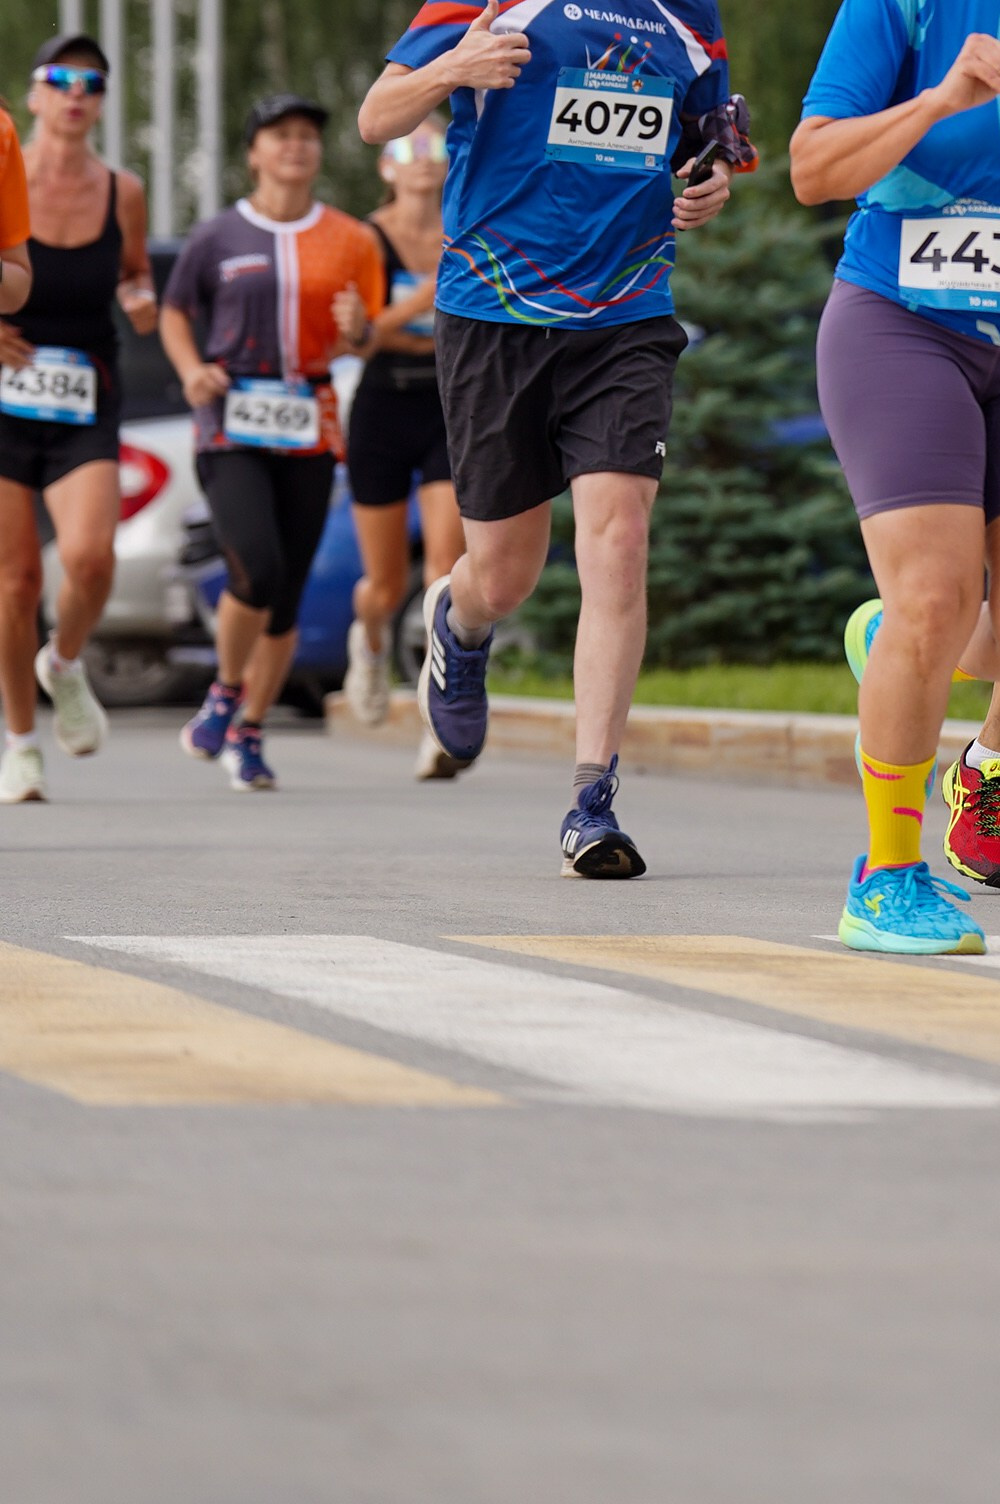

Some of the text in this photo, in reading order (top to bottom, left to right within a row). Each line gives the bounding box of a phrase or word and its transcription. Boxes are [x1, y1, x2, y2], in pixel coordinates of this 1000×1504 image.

[584, 7, 667, 35] ЧЕЛИНДБАНК
[589, 72, 629, 83] МАРАФОН
[556, 98, 663, 140] 4079
[568, 138, 643, 152] Антоненко Александр
[595, 153, 604, 162] 10
[8, 368, 88, 398] 4384
[235, 400, 311, 431] 4269
